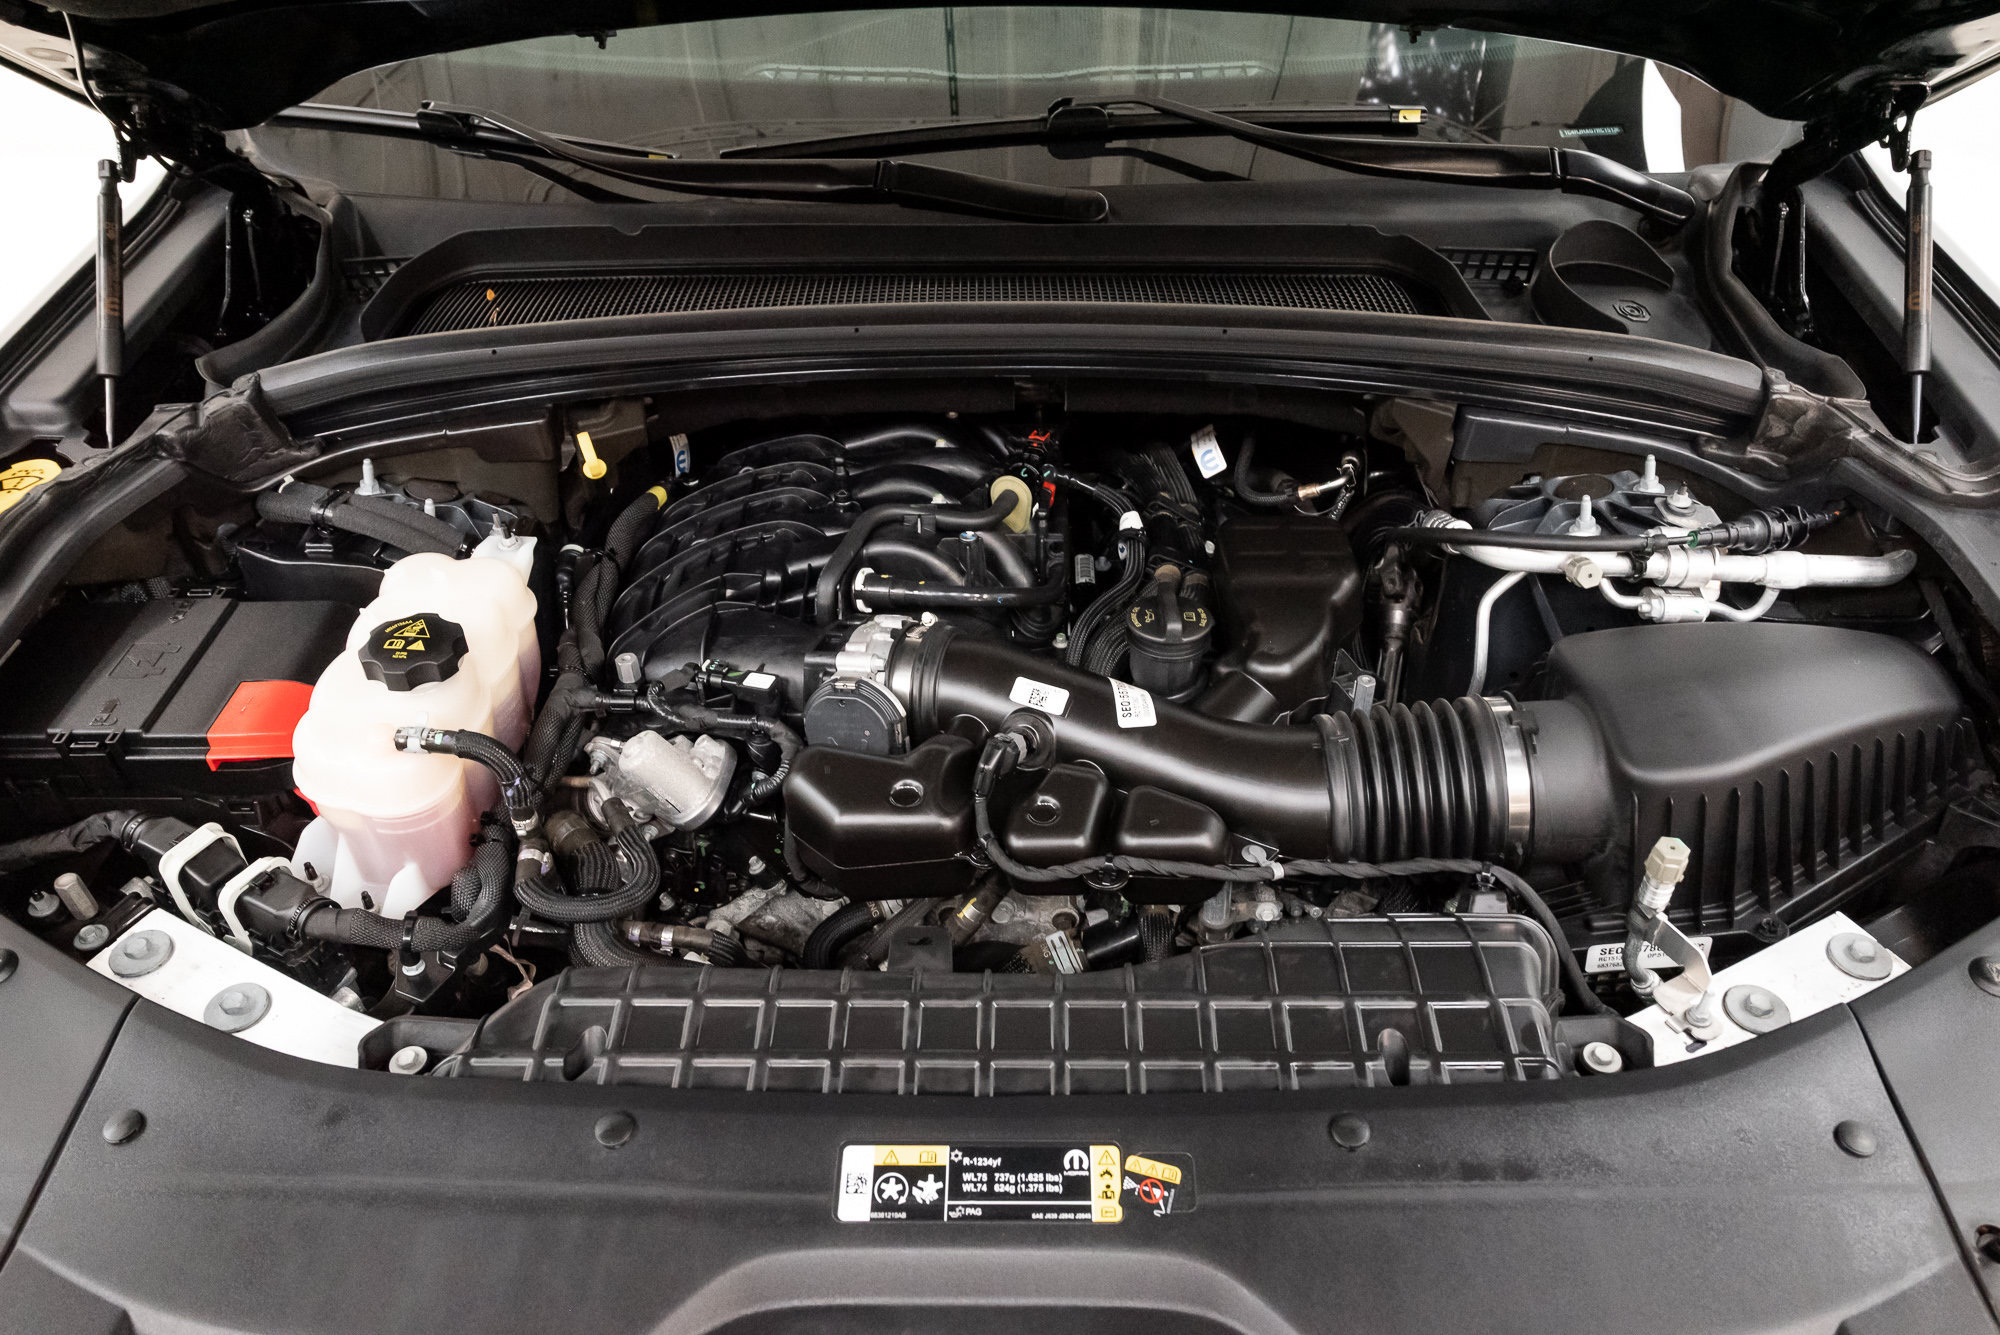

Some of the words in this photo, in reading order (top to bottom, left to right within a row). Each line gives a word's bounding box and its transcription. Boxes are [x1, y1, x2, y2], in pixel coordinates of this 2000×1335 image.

[963, 1157, 1001, 1167] R-1234yf
[962, 1172, 988, 1182] WL75
[994, 1172, 1016, 1184] 737g
[1017, 1172, 1045, 1184] (1.625
[1046, 1172, 1063, 1184] lbs)
[962, 1183, 988, 1193] WL74
[994, 1183, 1016, 1194] 624g
[1017, 1183, 1045, 1194] (1.375
[1046, 1183, 1064, 1194] lbs)
